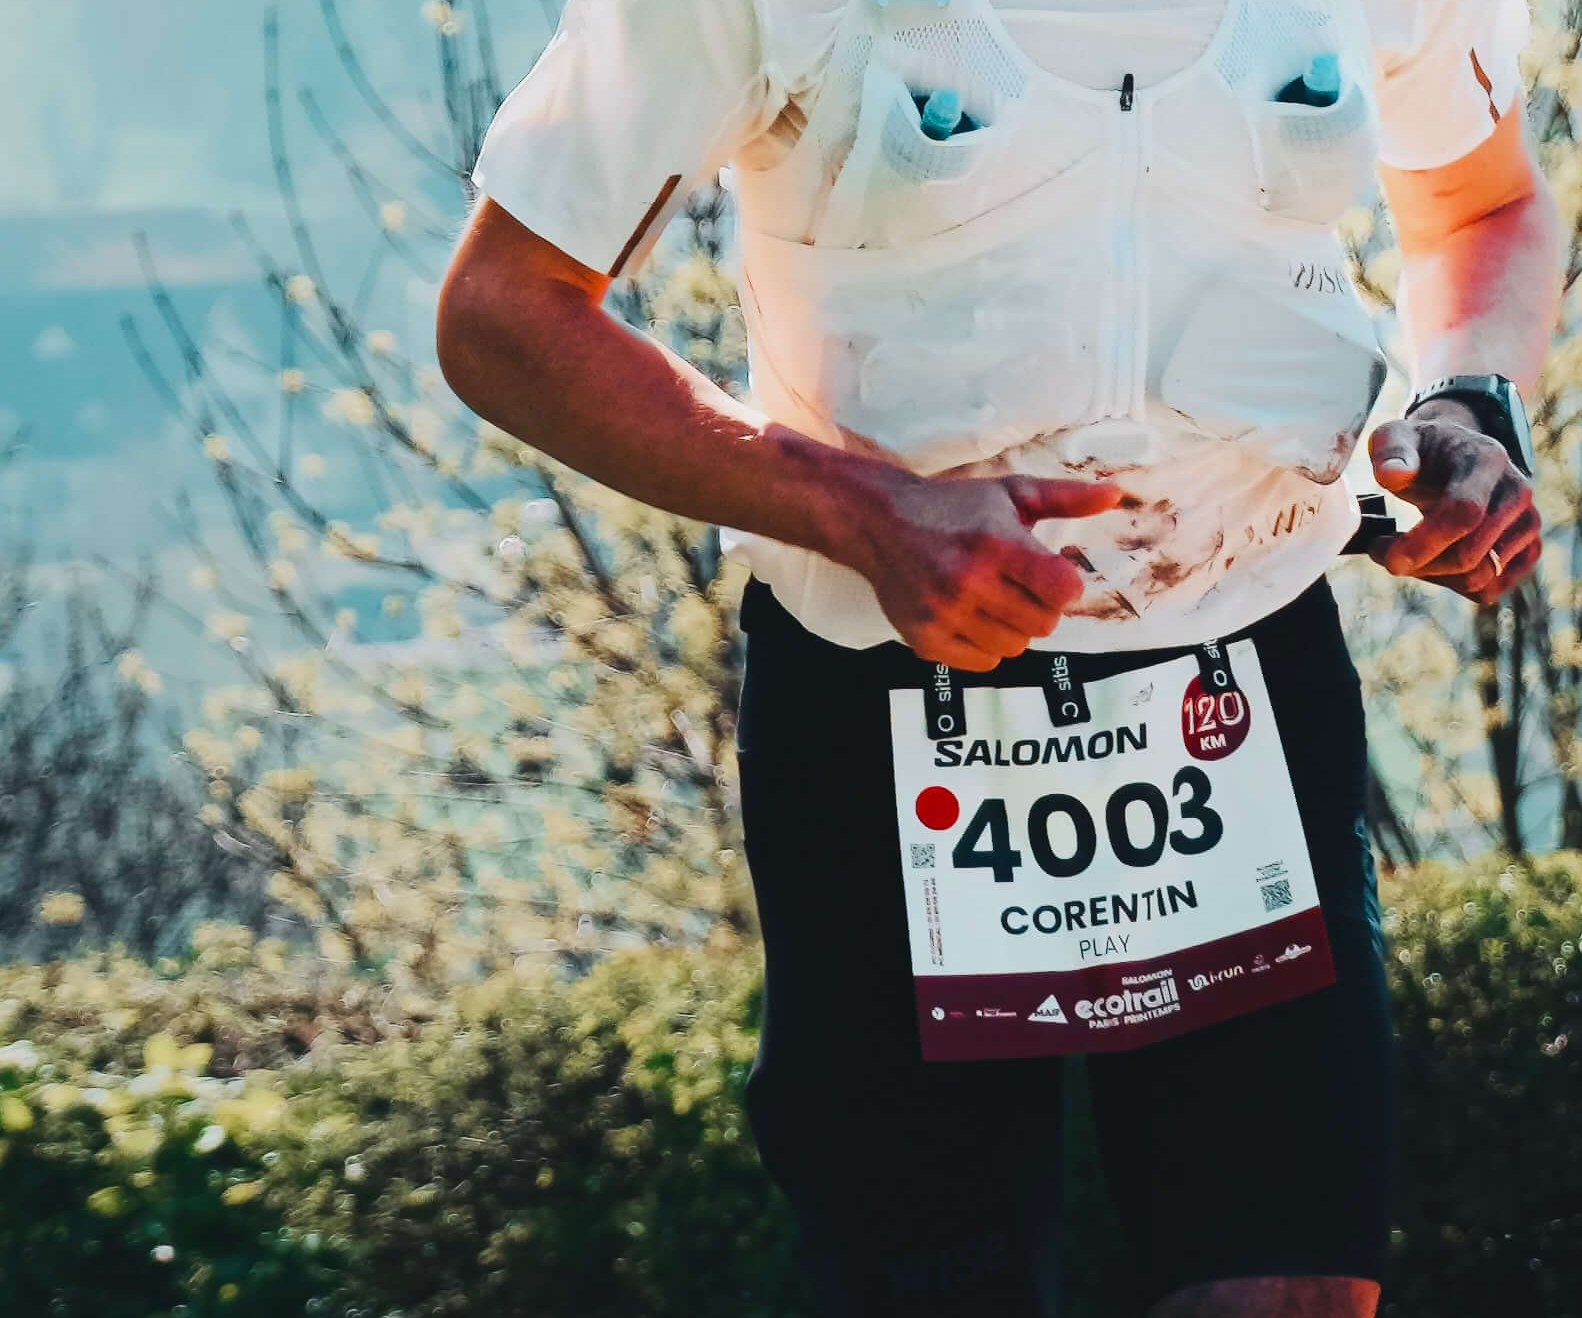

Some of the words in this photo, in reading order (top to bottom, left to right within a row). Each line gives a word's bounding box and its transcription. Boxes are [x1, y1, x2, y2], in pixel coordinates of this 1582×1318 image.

[1184, 691, 1245, 735] 120
[934, 723, 1148, 767] SALOMON
[1200, 733, 1227, 751] KM
[952, 766, 1224, 882] 4003
[1001, 881, 1198, 935] CORENTIN
[1079, 934, 1130, 961] PLAY
[1121, 968, 1173, 985] SALOMON
[1074, 978, 1180, 1019] ecotrail
